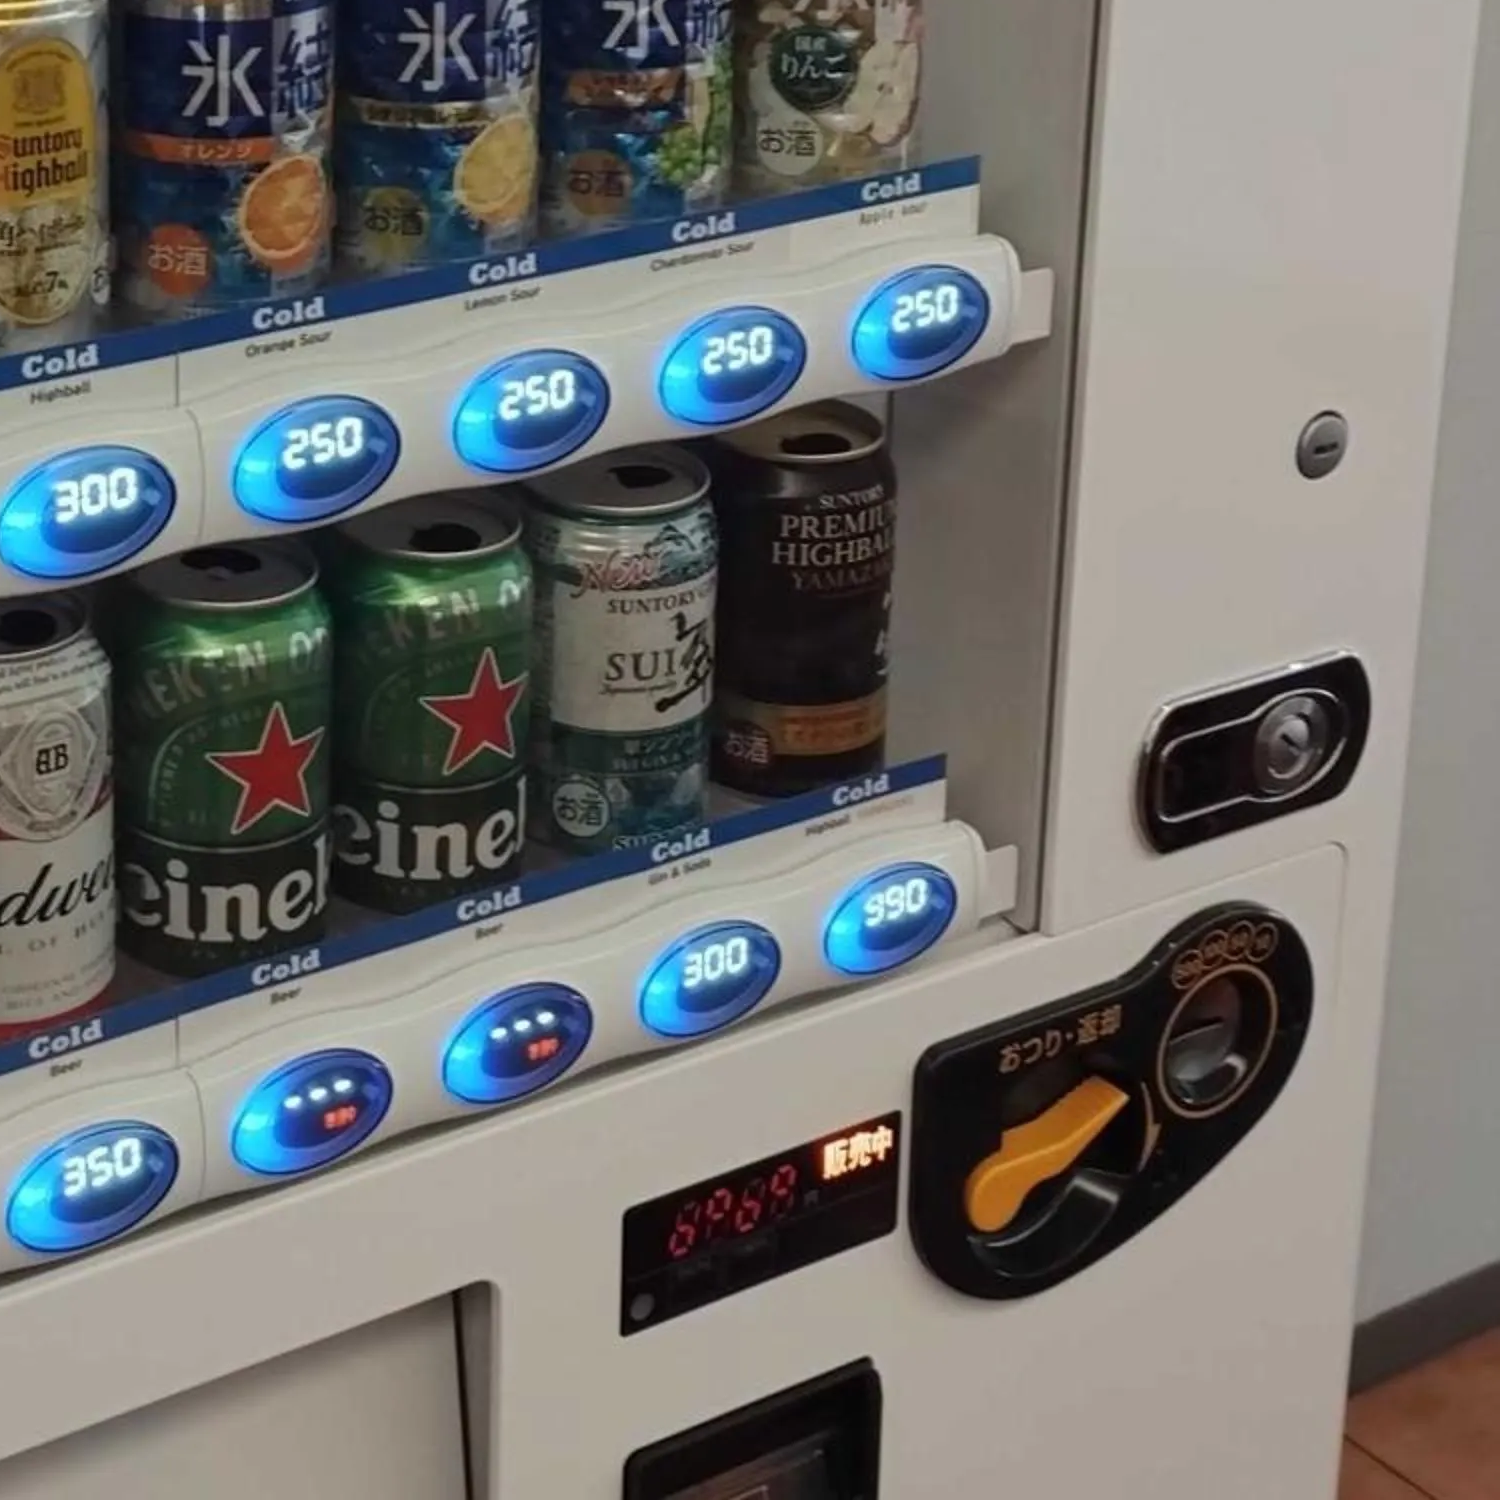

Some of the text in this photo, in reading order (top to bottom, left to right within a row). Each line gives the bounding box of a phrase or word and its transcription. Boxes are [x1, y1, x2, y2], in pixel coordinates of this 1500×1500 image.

[780, 50, 848, 81] りんご
[759, 127, 817, 157] お酒
[861, 172, 922, 201] Cold
[364, 206, 425, 237] お酒
[671, 212, 735, 243] Cold
[148, 244, 208, 276] お酒
[727, 240, 755, 255] Sour
[468, 253, 537, 285] Cold
[252, 296, 325, 330] Cold
[464, 285, 541, 312] Lemon Sour
[891, 284, 960, 333] 250
[245, 330, 332, 358] Orange Sour
[702, 326, 773, 375] 250
[21, 344, 99, 380] Cold
[29, 381, 91, 406] Highball
[499, 369, 576, 421] 250
[282, 417, 364, 470] 250
[53, 466, 138, 523] 300
[605, 649, 676, 682] SUI
[832, 773, 890, 806] Cold
[557, 793, 604, 826] お酒
[651, 828, 711, 863] Cold
[457, 887, 522, 922] Cold
[474, 923, 504, 940] Beer
[251, 948, 321, 986] Cold
[683, 936, 749, 989] 300
[270, 987, 302, 1005] Beer
[28, 1019, 104, 1059] Cold
[49, 1057, 83, 1077] Beer
[62, 1138, 143, 1197] 350
[823, 1125, 894, 1180] 販売中
